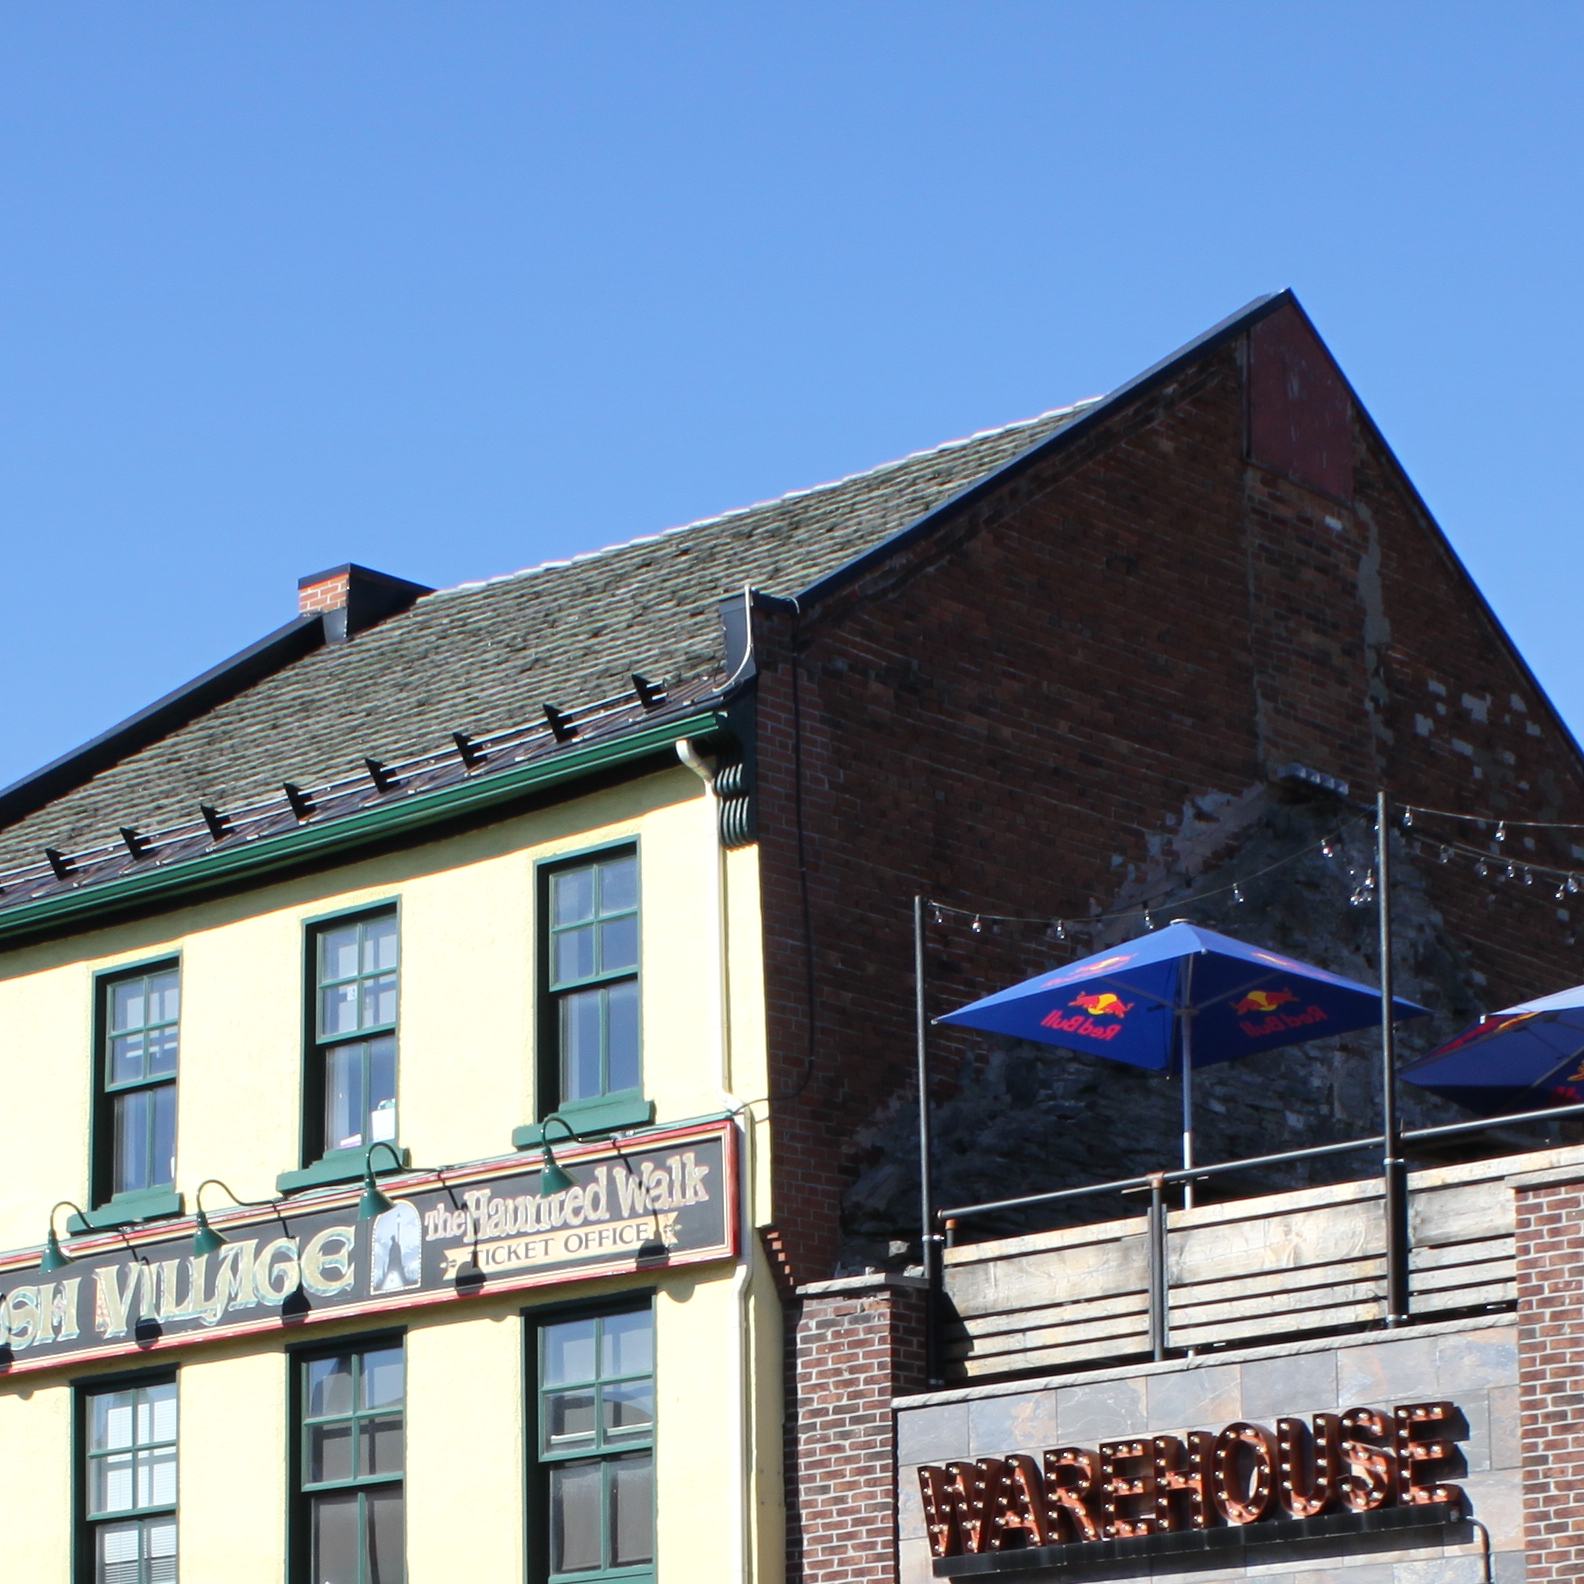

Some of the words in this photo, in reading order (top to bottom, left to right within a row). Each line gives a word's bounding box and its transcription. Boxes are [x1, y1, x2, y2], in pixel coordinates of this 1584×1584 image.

[425, 1203, 467, 1241] The
[462, 1164, 609, 1243] Haunted
[613, 1151, 710, 1219] Walk
[469, 1236, 555, 1267] TICKET
[563, 1221, 650, 1252] OFFICE
[92, 1225, 357, 1339] VILLAGE
[918, 1401, 1457, 1557] WAREHOUSE
